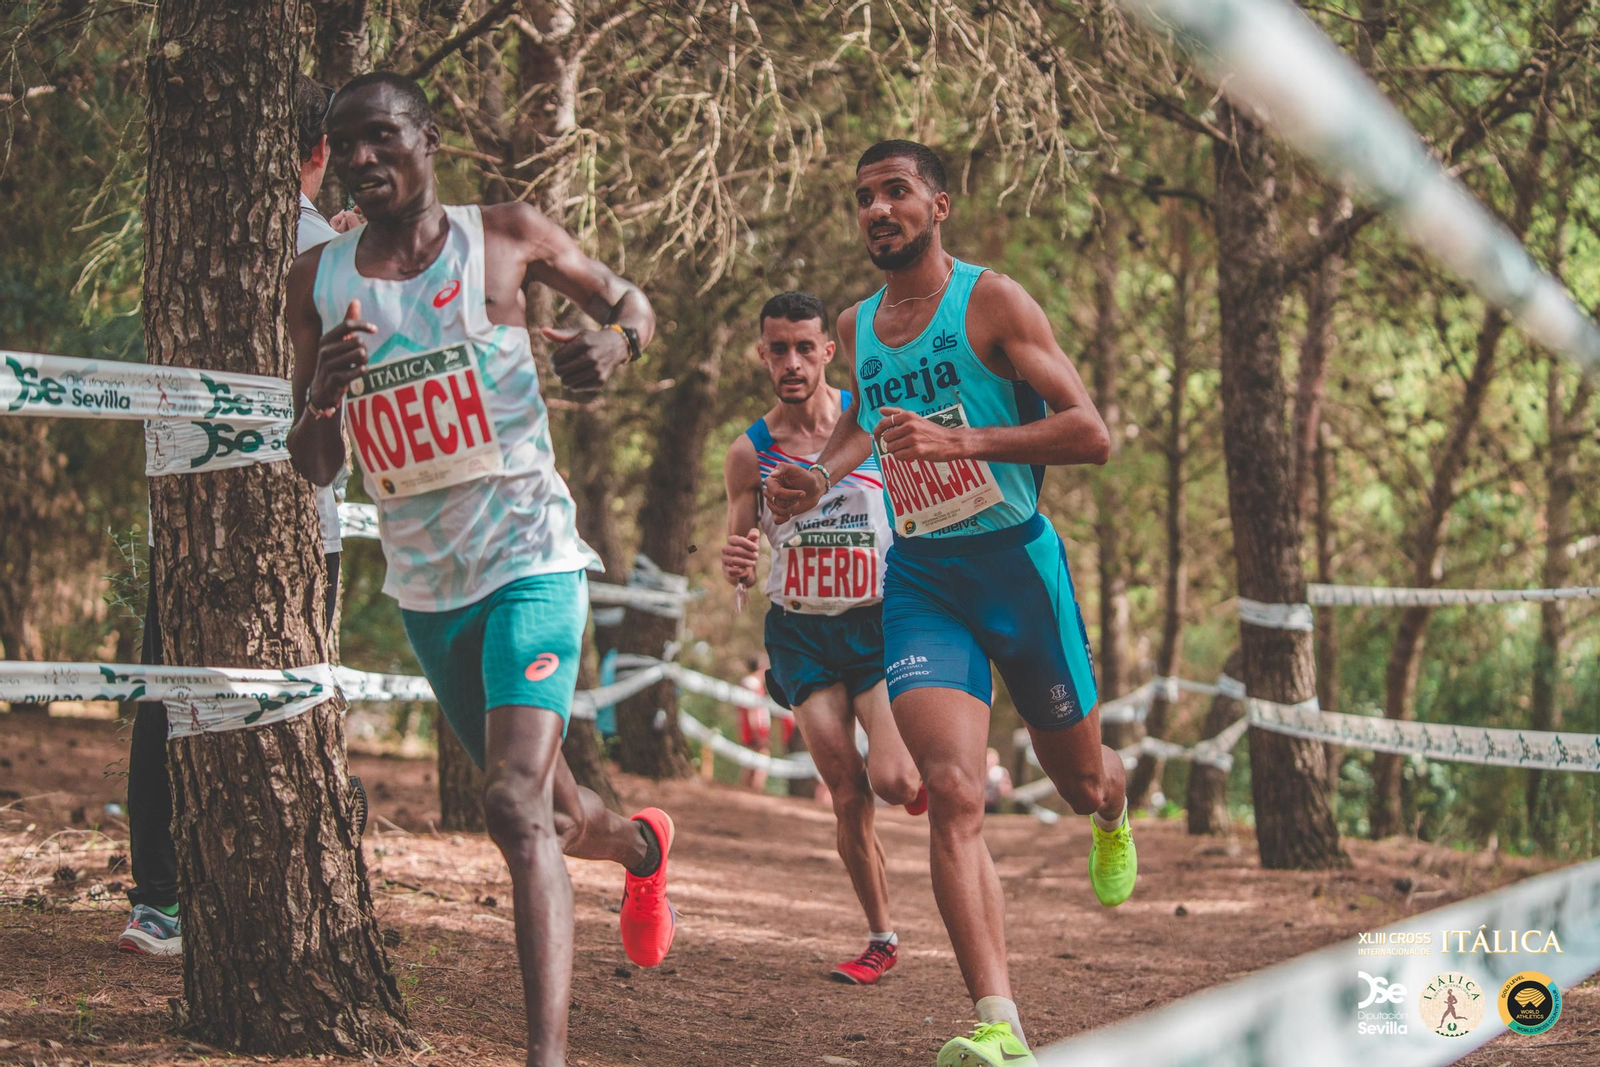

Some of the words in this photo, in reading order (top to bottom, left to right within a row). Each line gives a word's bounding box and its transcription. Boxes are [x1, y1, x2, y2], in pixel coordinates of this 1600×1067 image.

[369, 358, 435, 389] ITÁLICA
[861, 361, 882, 378] TROPS
[864, 357, 961, 411] nerja
[72, 387, 131, 409] Sevilla
[347, 369, 492, 474] KOECH
[841, 513, 868, 525] Run
[784, 547, 877, 598] AFERDI
[886, 654, 929, 675] nerja
